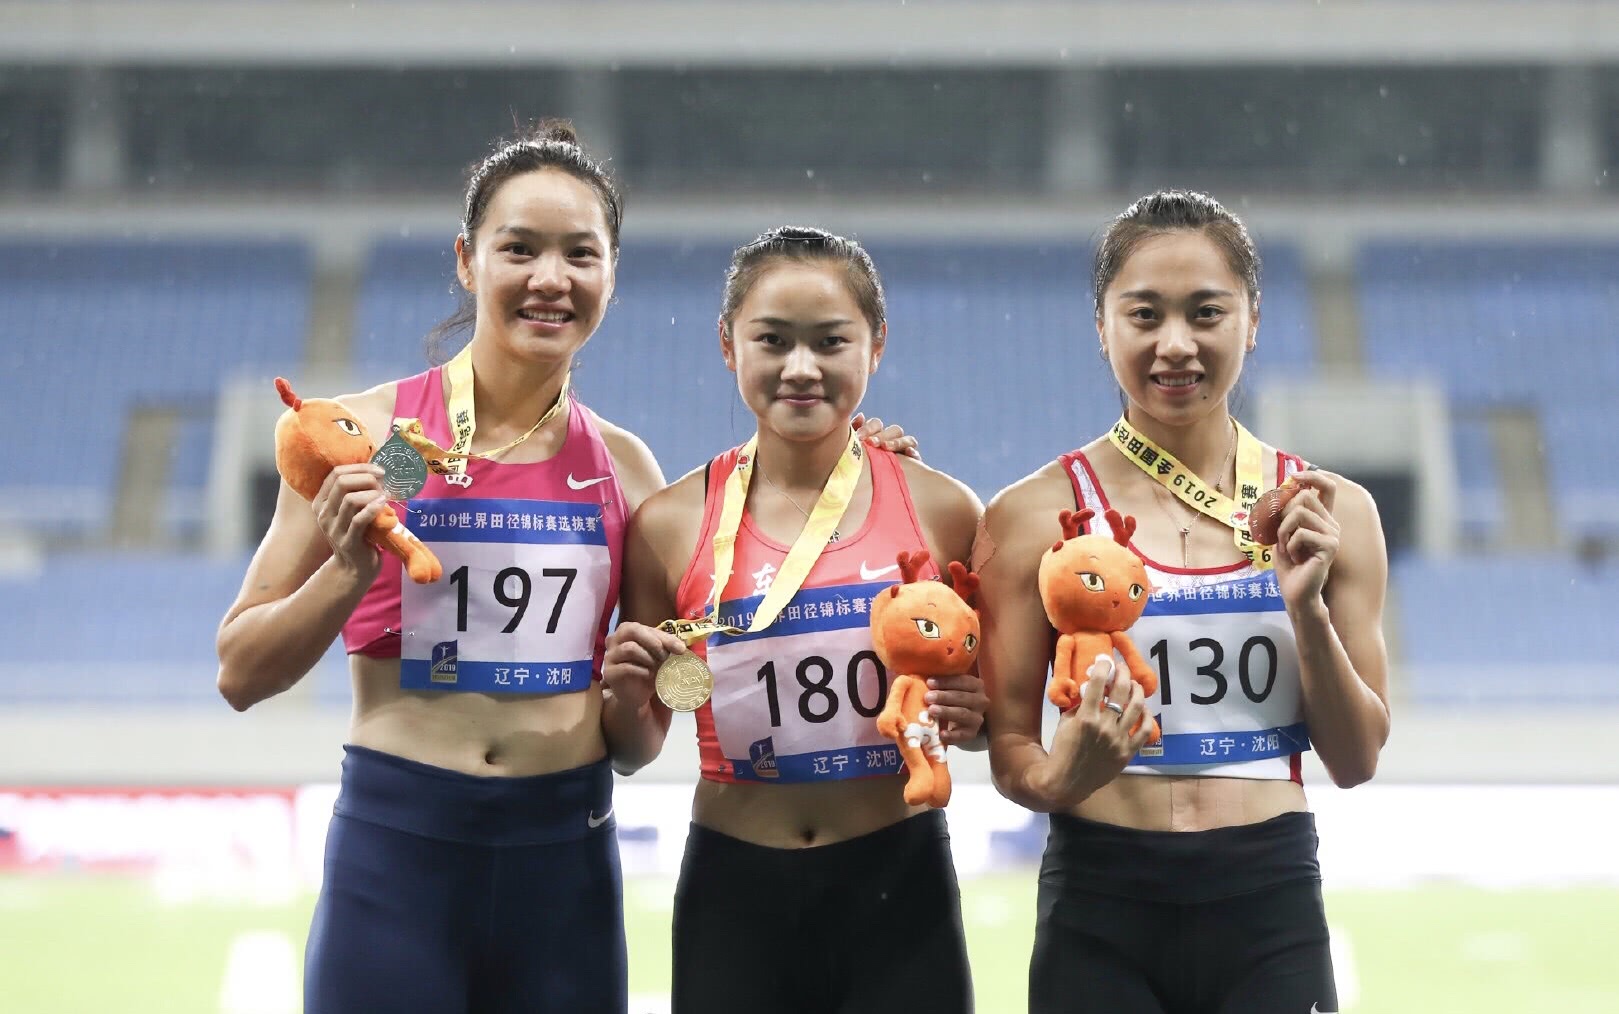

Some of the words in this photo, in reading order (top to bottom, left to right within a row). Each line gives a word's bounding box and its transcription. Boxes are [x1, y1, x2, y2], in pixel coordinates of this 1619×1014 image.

[1113, 423, 1175, 476] 全国田径
[1173, 474, 1218, 509] 2019
[419, 511, 597, 533] 2019世界田径锦标赛选拔赛
[449, 565, 578, 634] 197
[718, 597, 877, 629] 2019田径锦标赛
[439, 663, 456, 672] 2019
[494, 667, 572, 686] 辽宁·沈阳
[1149, 635, 1278, 706] 130
[756, 649, 888, 728] 180
[1200, 734, 1280, 756] 辽宁·沈阳
[812, 749, 898, 775] 辽宁·沈阳
